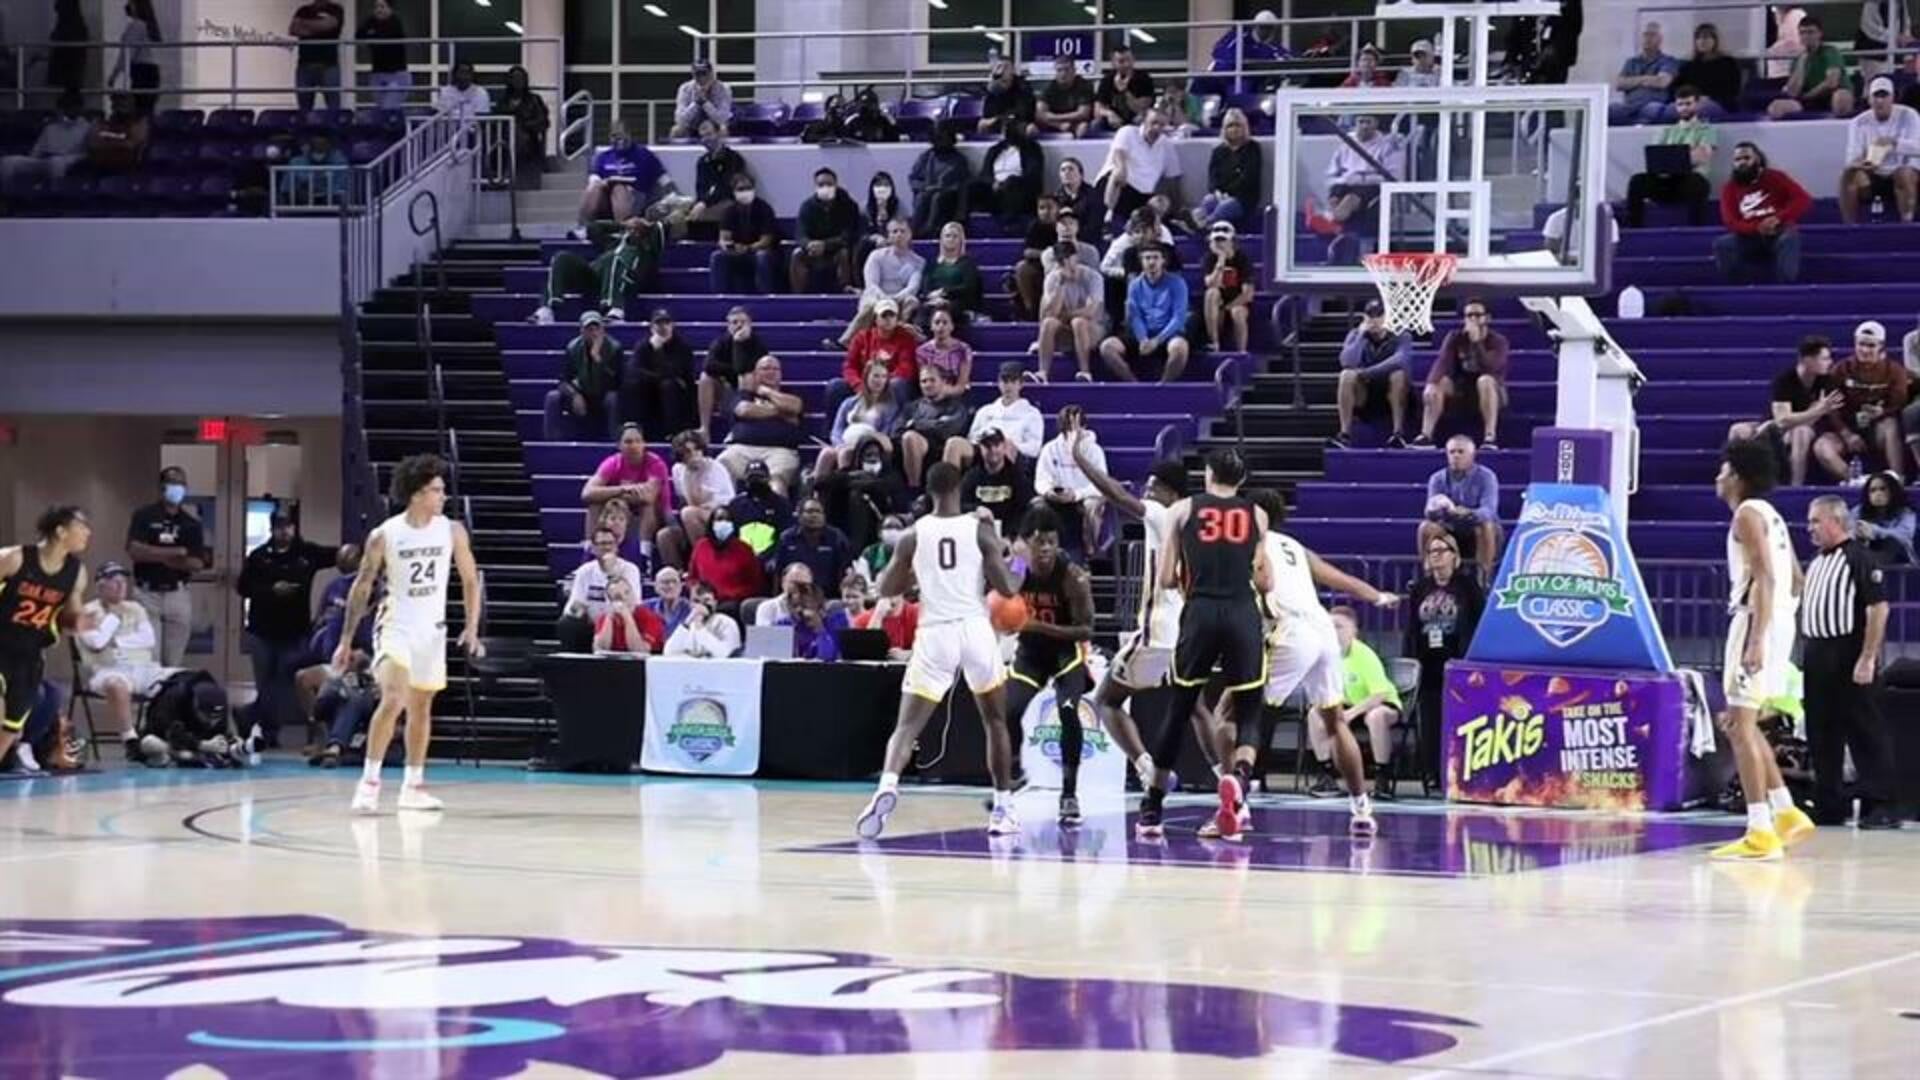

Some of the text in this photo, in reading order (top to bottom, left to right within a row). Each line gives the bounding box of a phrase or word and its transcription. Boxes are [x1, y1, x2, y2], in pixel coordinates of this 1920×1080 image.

[1055, 38, 1081, 55] 101
[1198, 506, 1250, 543] 30
[938, 538, 956, 570] 0
[1281, 541, 1296, 566] 5
[410, 560, 435, 584] 24
[1514, 575, 1617, 599] CITY OF PALMS
[13, 601, 52, 629] 24
[1529, 597, 1596, 619] CLASSIC
[1563, 715, 1629, 749] MOST
[1457, 713, 1545, 781] Takis
[1560, 744, 1639, 773] INTENSE
